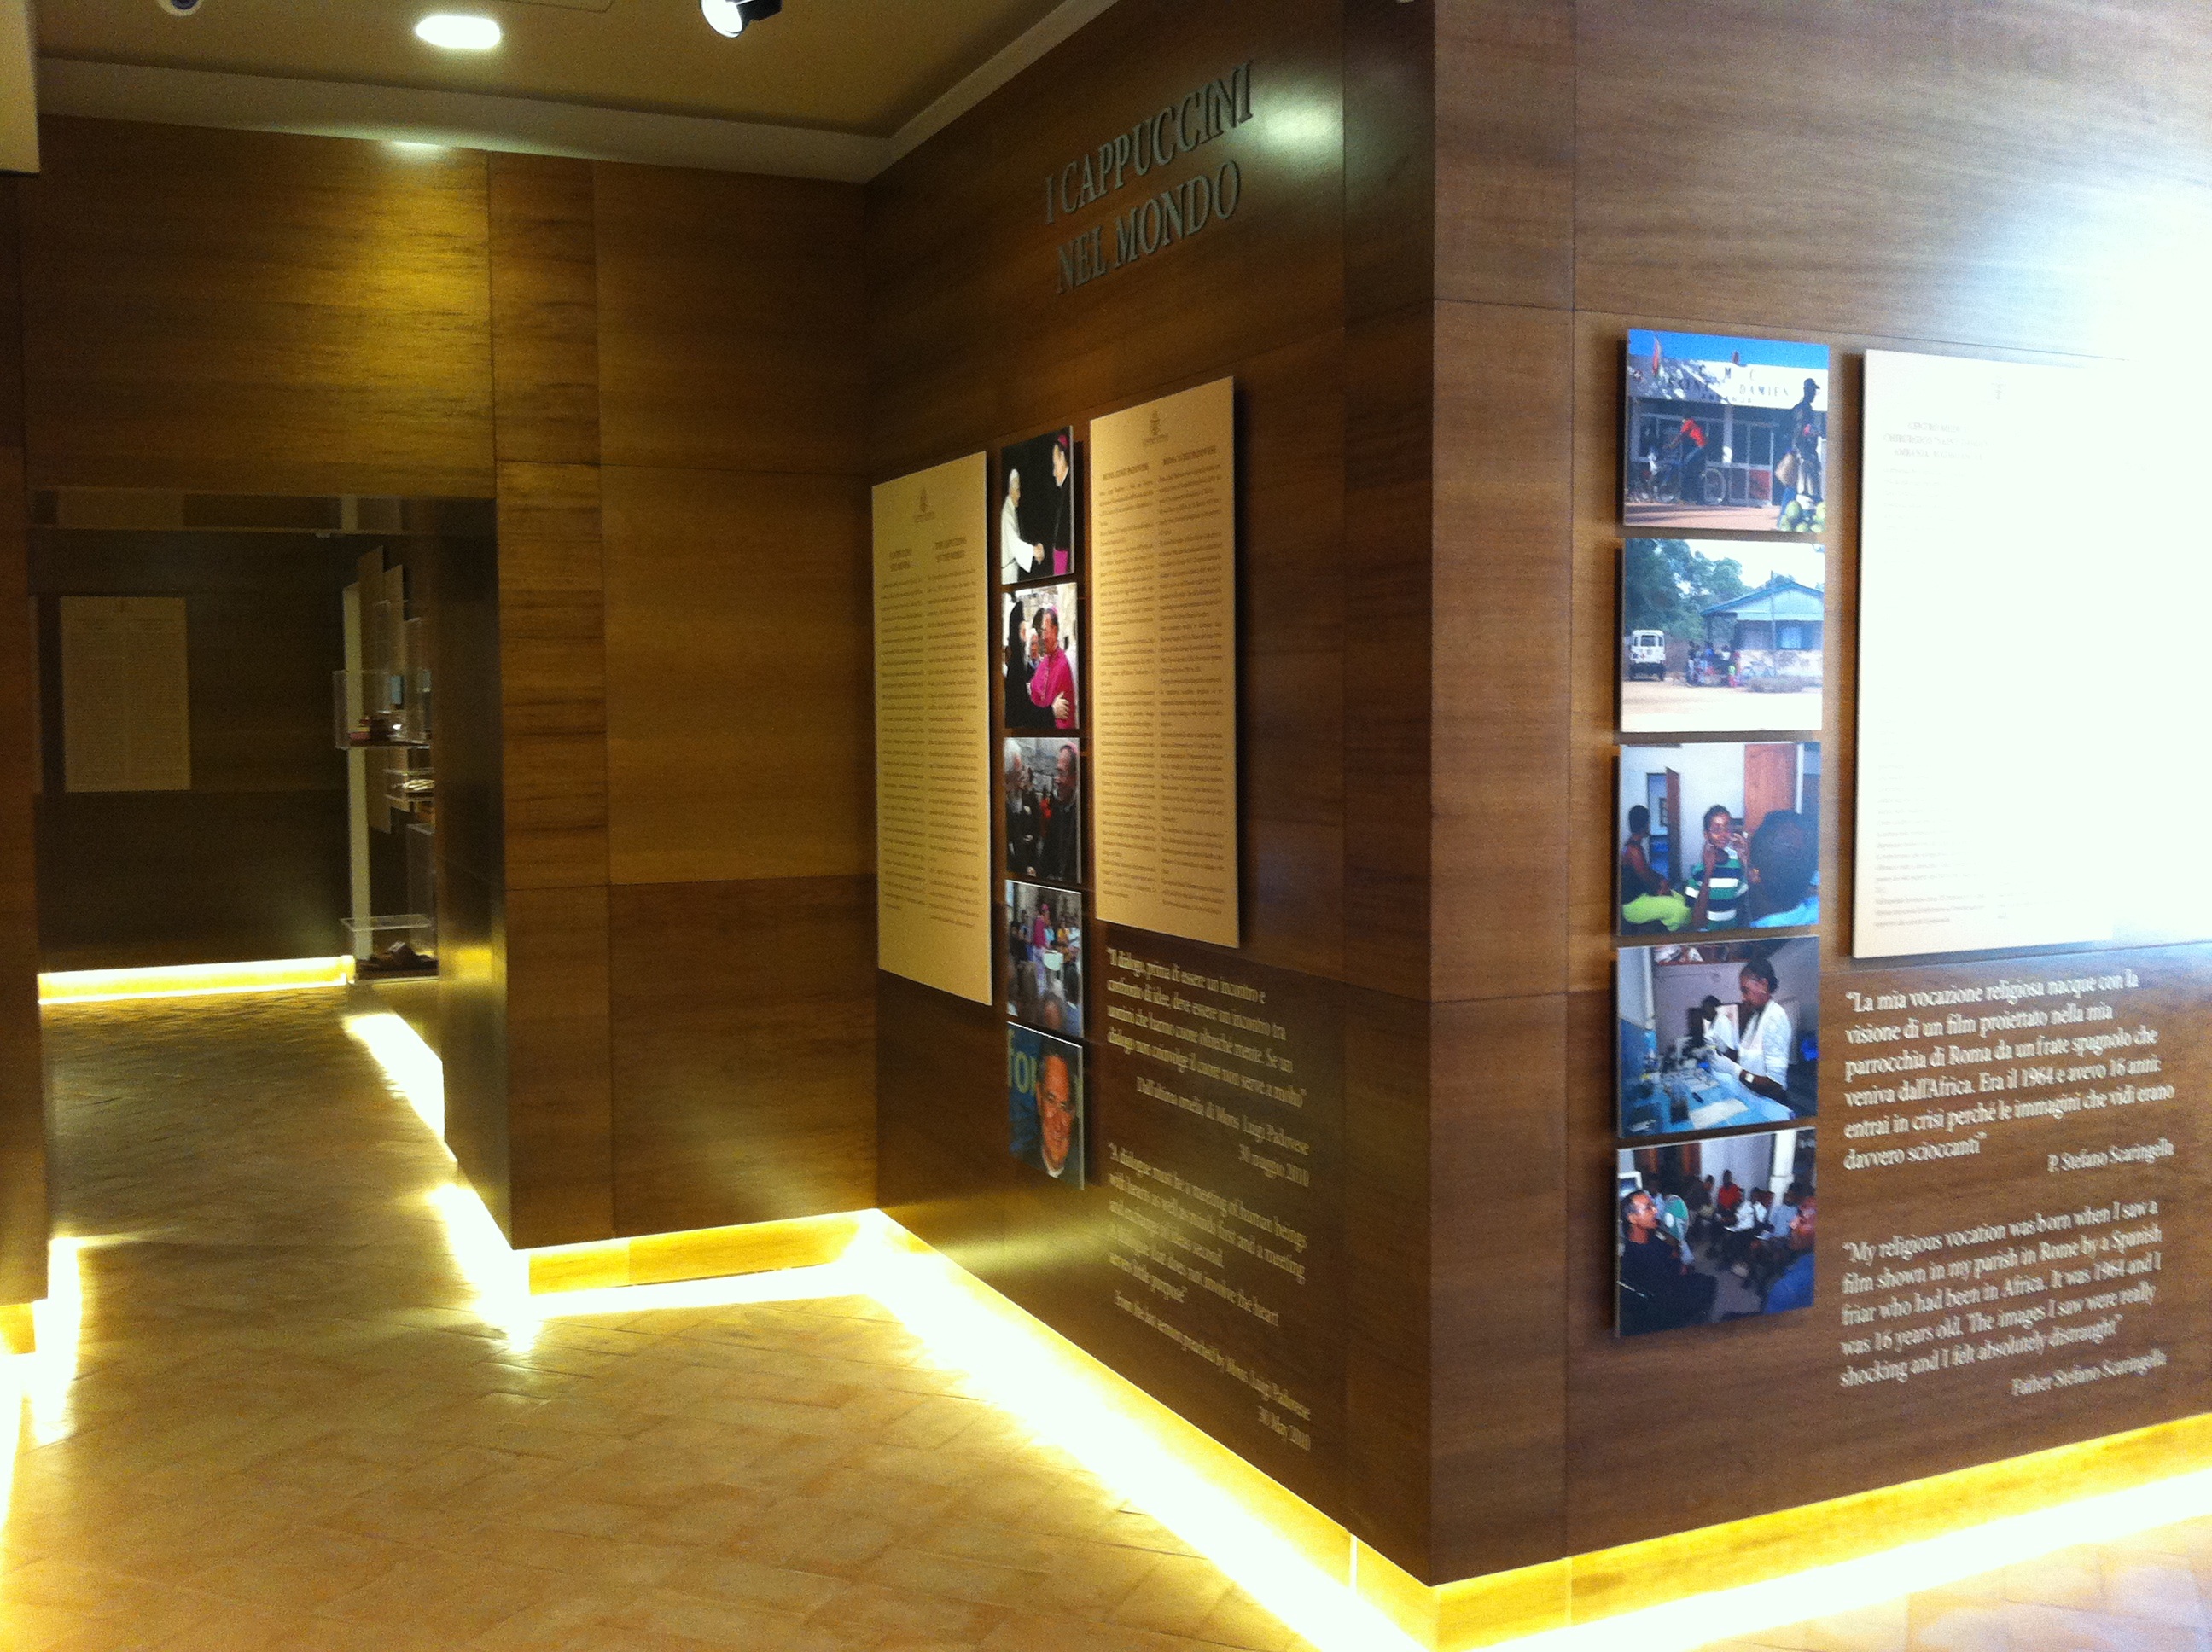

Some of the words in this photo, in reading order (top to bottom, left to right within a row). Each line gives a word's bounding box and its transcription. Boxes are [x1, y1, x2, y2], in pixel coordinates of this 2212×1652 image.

[1046, 176, 1055, 225] I
[1061, 59, 1254, 214] CAPPUCCINI
[1056, 225, 1107, 295] NEL
[1113, 159, 1242, 270] MONDO
[1846, 990, 1874, 1012] "La
[1877, 990, 1907, 1010] mia
[1908, 985, 1983, 1007] vocazione
[1985, 979, 2045, 1005] religiosa
[2046, 977, 2097, 999] nacque
[2098, 974, 2123, 990] con
[2124, 968, 2139, 988] la
[1845, 1023, 1901, 1044] visione
[1902, 1017, 1919, 1038] di
[1922, 1021, 1943, 1037] un
[1946, 1013, 1976, 1035] film
[1979, 1010, 2048, 1038] proiettato
[2050, 1003, 2084, 1024] nella
[2085, 1001, 2113, 1021] mia
[1845, 1049, 1927, 1083] parrocchia
[1929, 1045, 1946, 1067] di
[1947, 1045, 1992, 1065] Roma
[1994, 1039, 2013, 1060] da
[2014, 1043, 2035, 1058] un
[2035, 1034, 2070, 1056] frate
[2071, 1027, 2133, 1057] spagnolo
[2133, 1024, 2158, 1045] che
[1843, 1085, 1895, 1107] veniva
[1978, 1072, 2005, 1091] Era
[2006, 1068, 2017, 1089] il
[2021, 1067, 2055, 1087] 1964
[2055, 1068, 2066, 1084] e
[2066, 1064, 2107, 1082] avevo
[2110, 1057, 2126, 1077] 16
[1844, 1114, 1890, 1139] entrai
[1892, 1114, 1909, 1133] in
[1911, 1108, 1944, 1131] crisi
[1946, 1101, 1996, 1133] perché
[1998, 1099, 2012, 1120] le
[2014, 1092, 2081, 1120] immagini
[2082, 1089, 2107, 1109] che
[2108, 1085, 2135, 1106] vidi
[2136, 1085, 2175, 1102] erano
[1843, 1148, 1905, 1170] davvero
[2061, 1149, 2108, 1171] Stefano
[1878, 1234, 1942, 1261] religious
[1944, 1223, 2005, 1247] vocation
[2008, 1220, 2036, 1236] was
[2035, 1213, 2072, 1232] born
[2073, 1206, 2110, 1226] when
[2113, 1201, 2121, 1221] I
[2122, 1202, 2147, 1219] saw
[2149, 1200, 2158, 1215] a
[1841, 1303, 1877, 1326] friar
[1877, 1295, 1912, 1319] who
[1913, 1288, 1943, 1313] had
[1944, 1287, 1981, 1308] been
[1982, 1282, 1999, 1301] in
[2126, 1252, 2153, 1275] and
[2153, 1250, 2162, 1271] I
[1842, 1271, 1874, 1294] film
[1877, 1266, 1926, 1289] shown
[1929, 1260, 1946, 1280] in
[1947, 1259, 1972, 1281] my
[1973, 1247, 2018, 1279] parish
[2020, 1246, 2037, 1265] in
[2039, 1242, 2079, 1261] Rome
[2099, 1237, 2110, 1251] a
[1840, 1338, 1871, 1356] was
[1875, 1329, 1893, 1351] 16
[1895, 1326, 1934, 1353] years
[1966, 1312, 1994, 1334] The
[1998, 1306, 2046, 1330] images
[2048, 1298, 2056, 1318] I
[2057, 1299, 2085, 1317] saw
[1840, 1359, 1908, 1387] shocking
[1910, 1348, 1940, 1374] and
[1941, 1347, 1949, 1368] I
